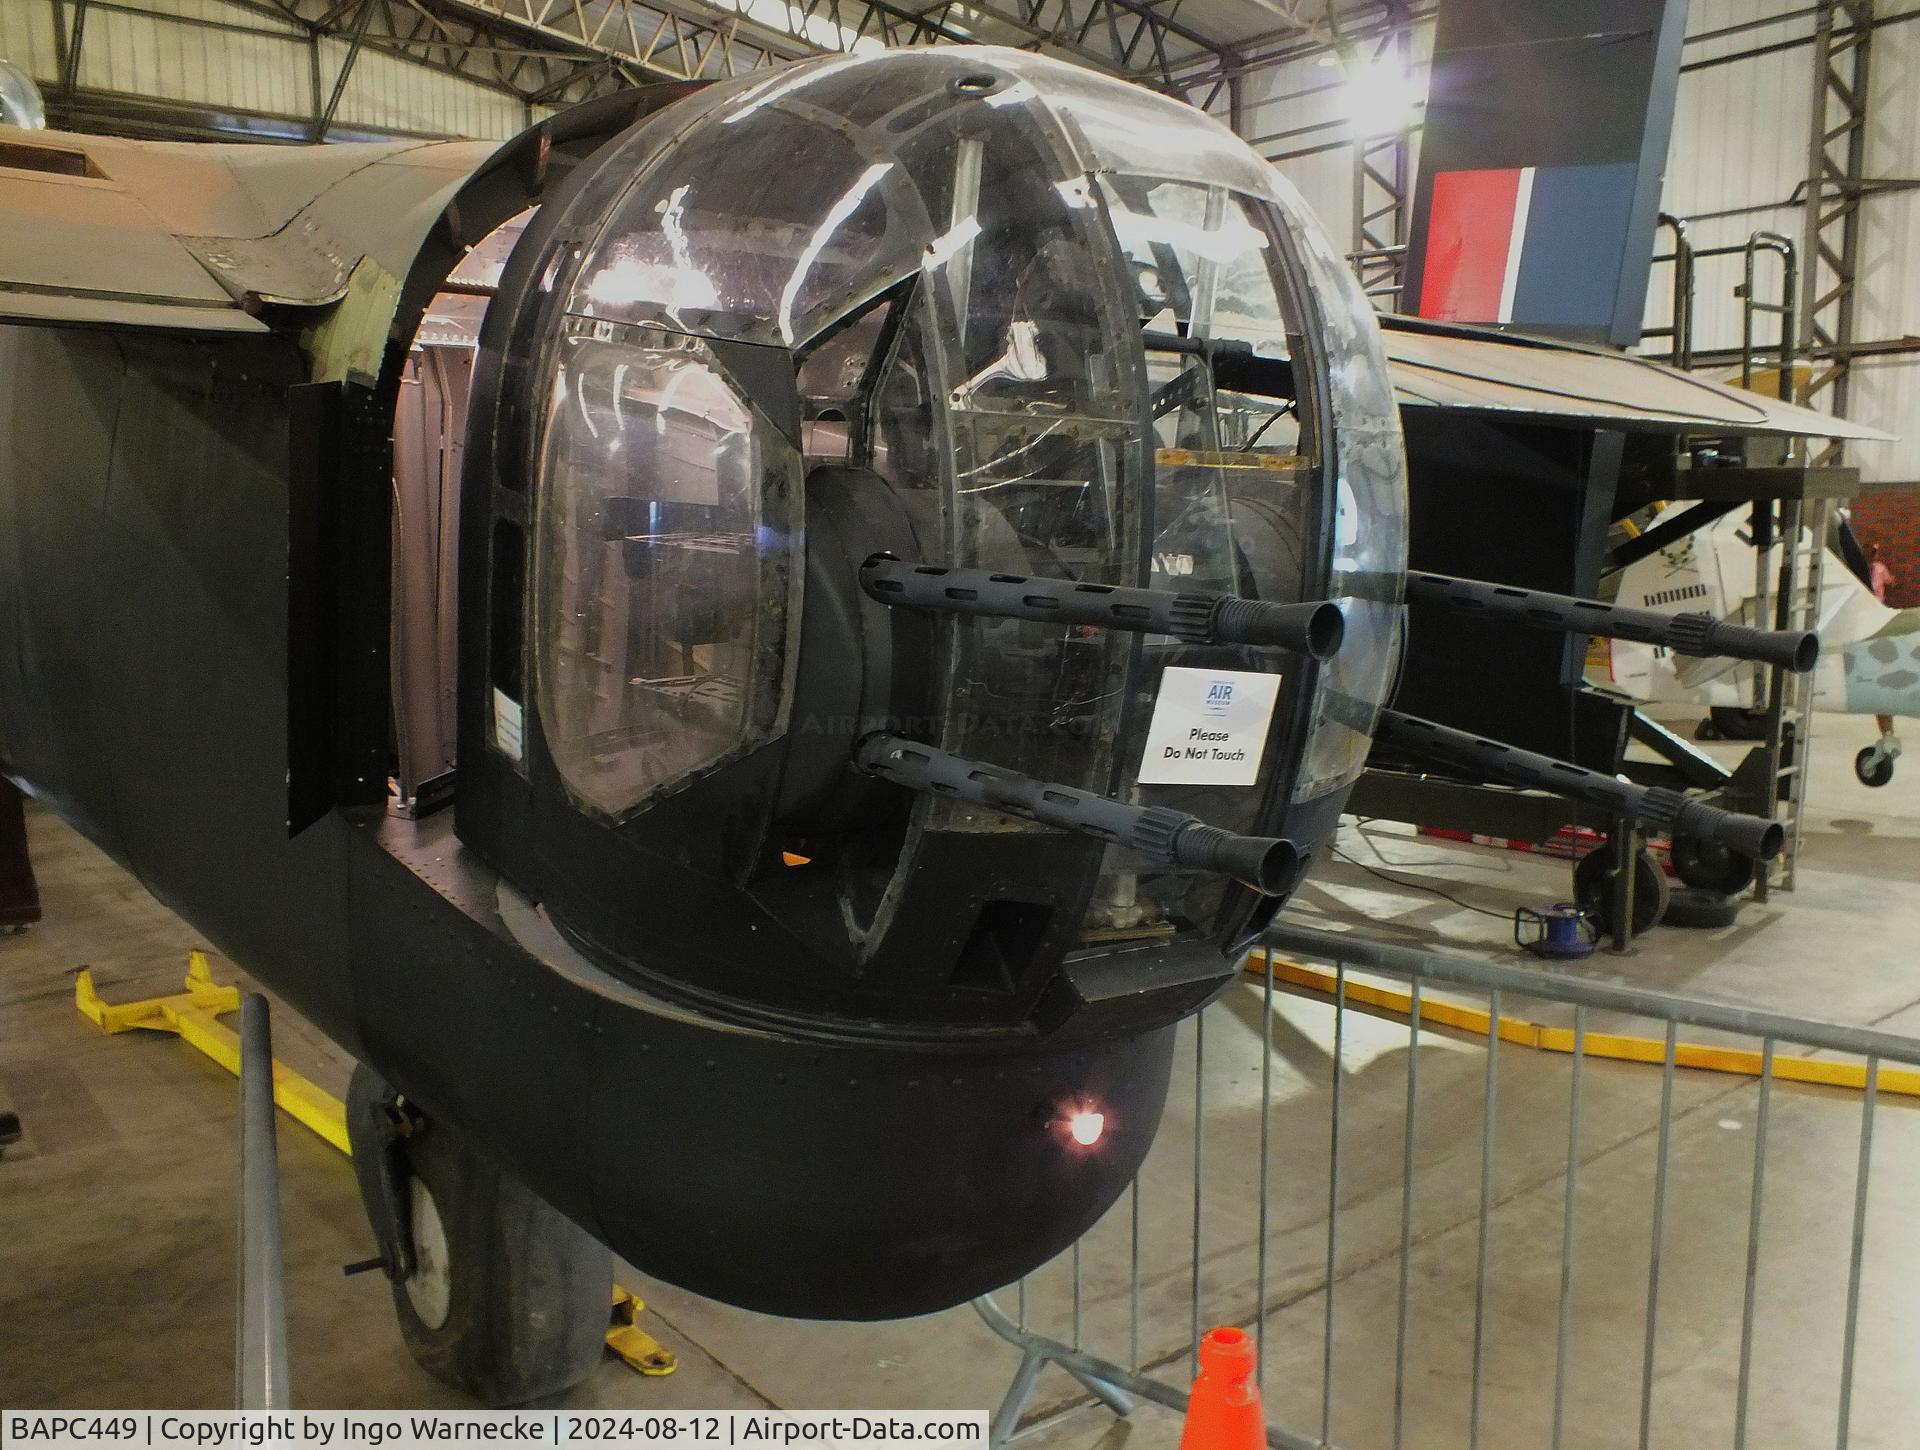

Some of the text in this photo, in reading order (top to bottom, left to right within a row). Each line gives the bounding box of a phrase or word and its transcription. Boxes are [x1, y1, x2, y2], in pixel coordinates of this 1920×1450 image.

[1208, 685, 1233, 700] AIR
[1189, 728, 1230, 742] Please
[1163, 746, 1245, 761] Do Not Touch
